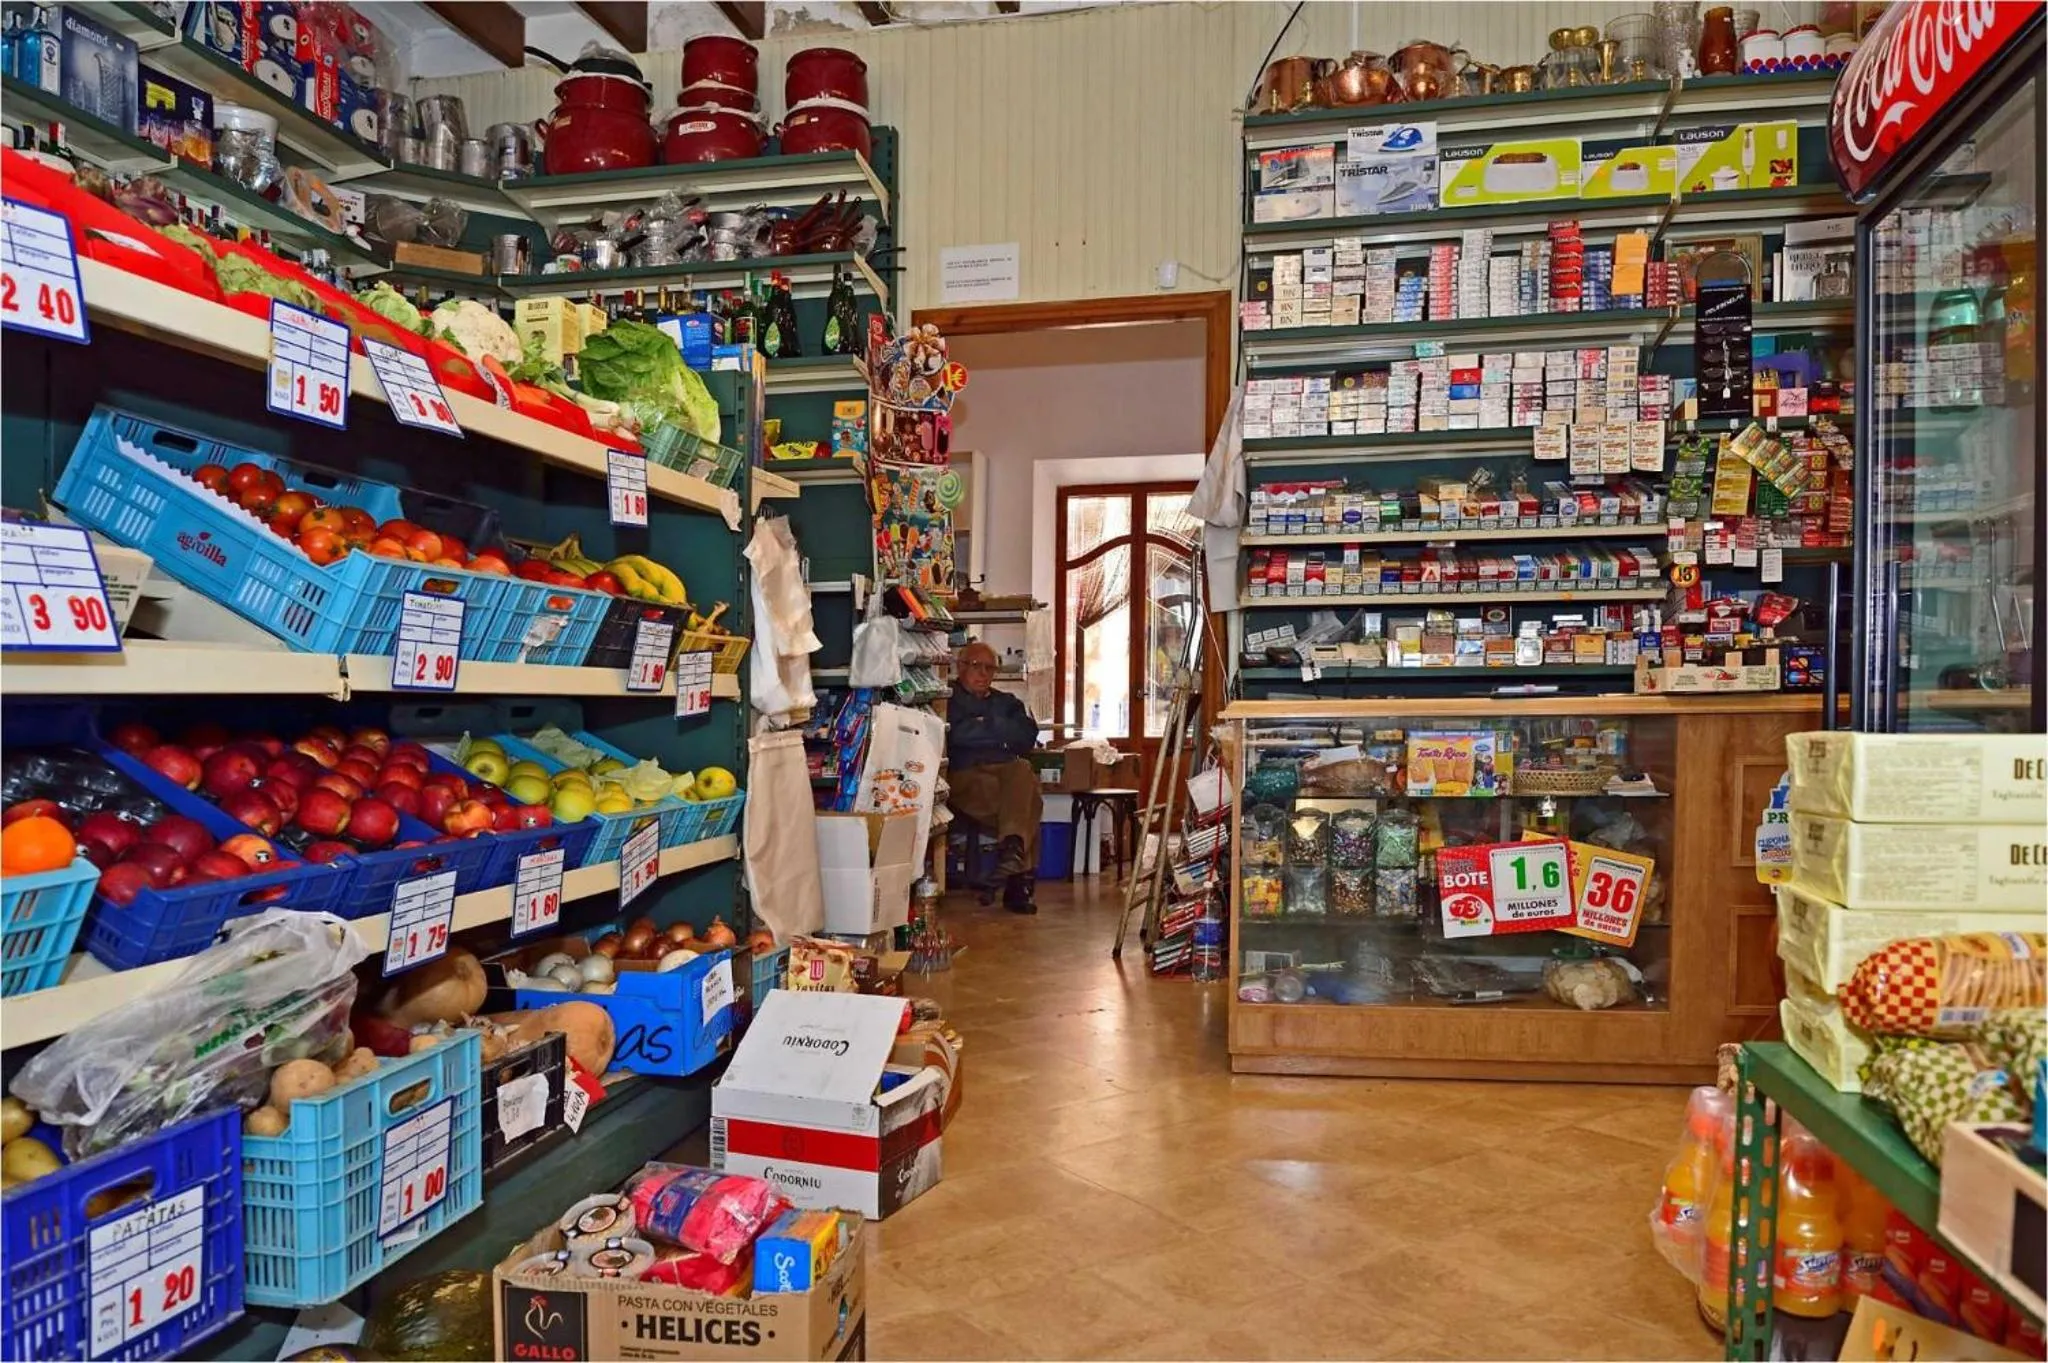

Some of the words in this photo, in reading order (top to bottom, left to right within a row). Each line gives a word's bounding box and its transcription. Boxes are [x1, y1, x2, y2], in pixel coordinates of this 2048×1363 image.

[65, 16, 109, 45] diamond
[1340, 165, 1388, 177] TRISTAR
[0, 272, 19, 312] 2
[38, 283, 75, 326] 40
[296, 375, 307, 406] 1
[319, 382, 341, 416] 50
[624, 493, 630, 515] 1
[29, 593, 52, 631] 3
[67, 595, 107, 631] 90
[415, 653, 427, 681] 2
[435, 655, 454, 681] 90
[641, 663, 648, 683] 1
[689, 691, 695, 711] 1
[1443, 872, 1488, 888] BOTE
[1587, 871, 1637, 914] 36
[530, 897, 537, 921] 1
[1507, 899, 1558, 912] MILLONES
[1511, 909, 1525, 918] de
[1527, 908, 1556, 917] euros
[1582, 909, 1628, 927] MILLONES
[1583, 919, 1595, 927] de
[1597, 923, 1623, 933] euros
[407, 932, 418, 958] 1
[426, 923, 447, 953] 75
[403, 1182, 414, 1216] 1
[424, 1166, 445, 1203] 00
[112, 1200, 186, 1241] PATATAS
[129, 1287, 144, 1328] 1
[162, 1264, 195, 1311] 20
[617, 1294, 661, 1310] PASTA
[662, 1299, 693, 1312] CON
[695, 1301, 779, 1317] VEGETALES
[635, 1313, 762, 1347] HELICES
[514, 1342, 576, 1361] GALLO
